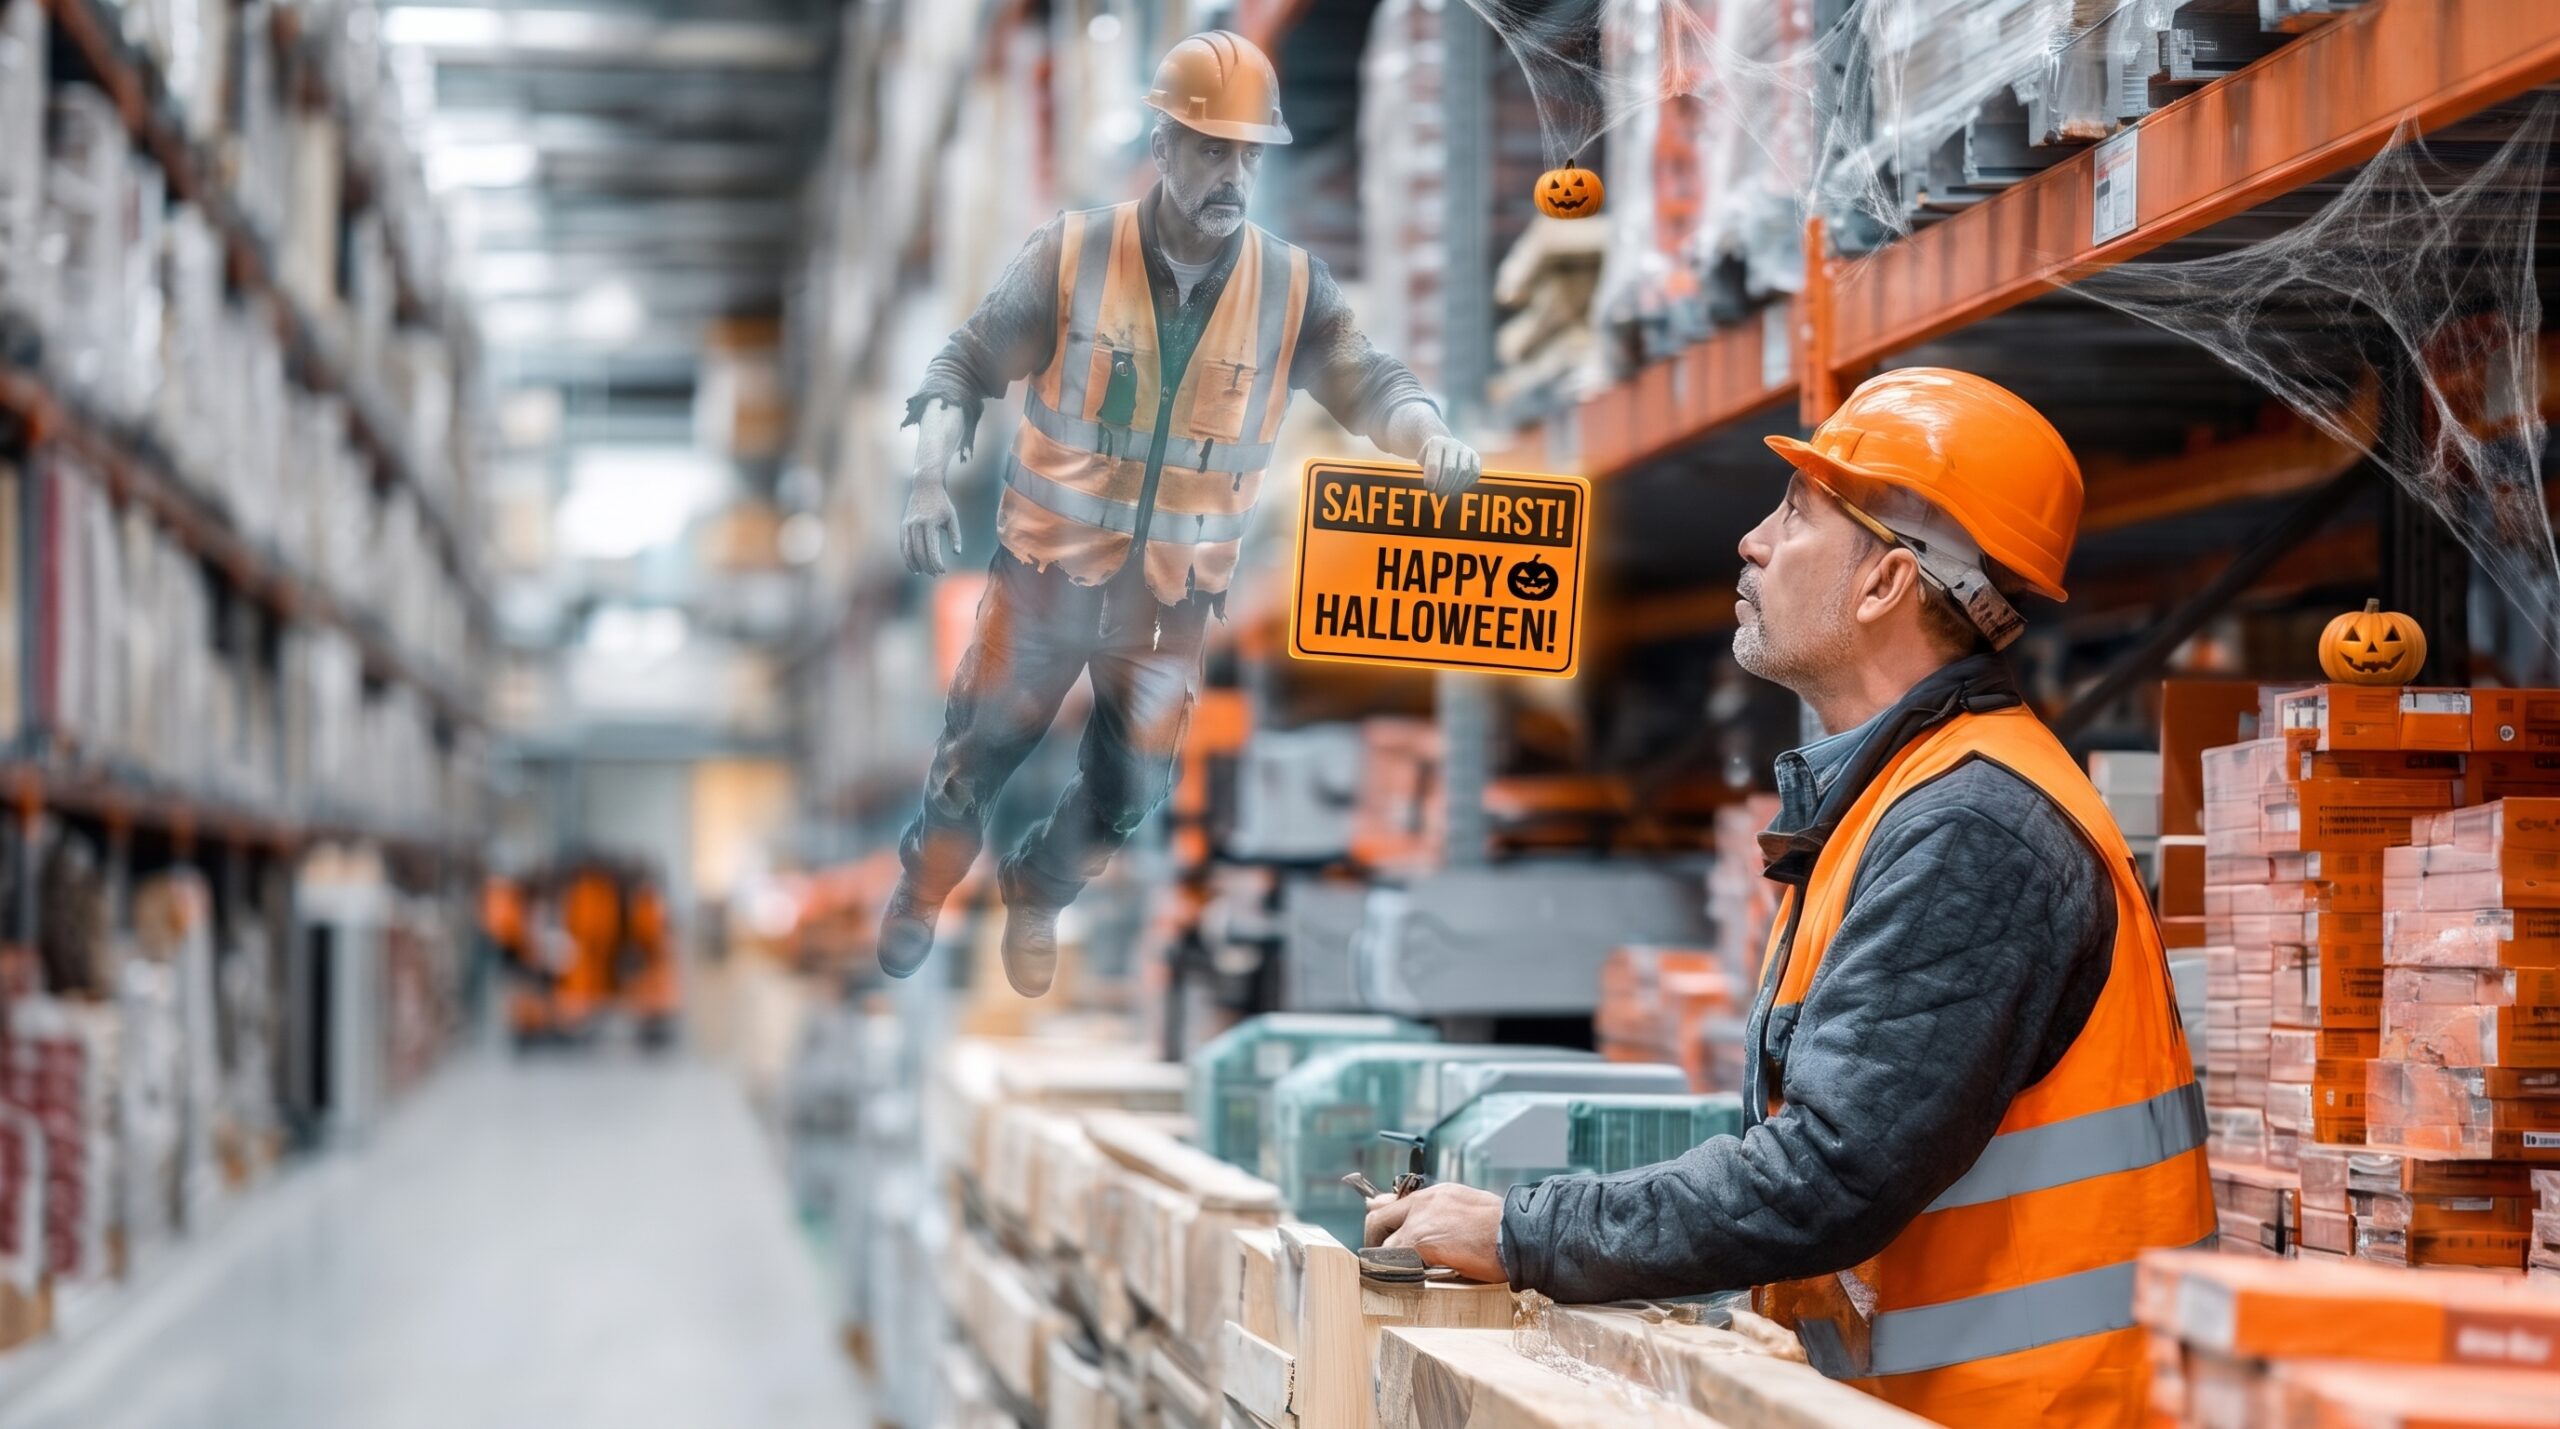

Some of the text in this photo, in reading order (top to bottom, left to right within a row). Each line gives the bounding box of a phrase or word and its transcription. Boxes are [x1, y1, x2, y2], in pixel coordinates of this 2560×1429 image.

[1322, 482, 1566, 539] SAFETY FIRST!
[1376, 547, 1503, 598] HAPPY
[1314, 593, 1557, 653] HALLOWEEN!
